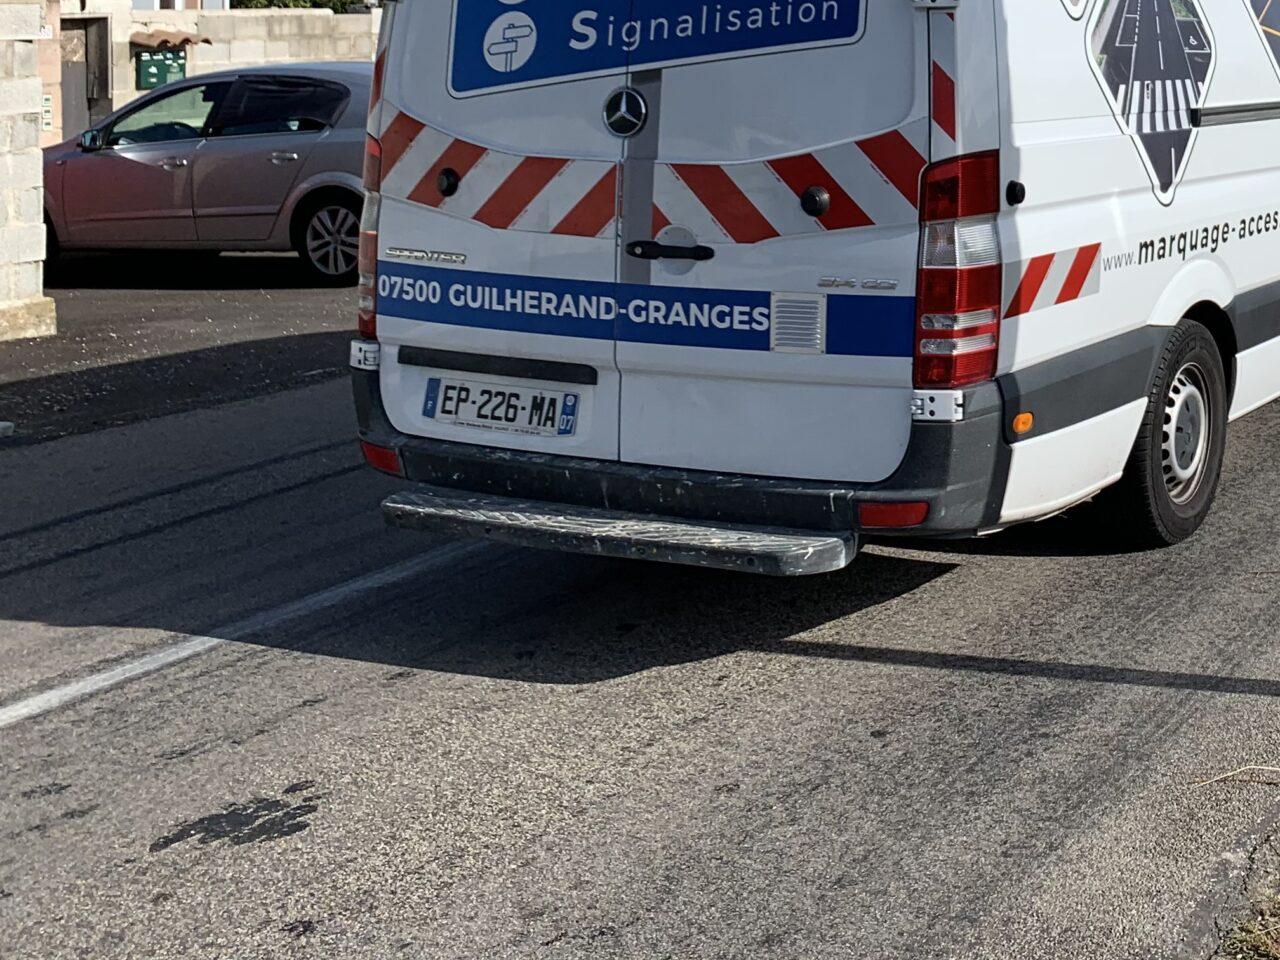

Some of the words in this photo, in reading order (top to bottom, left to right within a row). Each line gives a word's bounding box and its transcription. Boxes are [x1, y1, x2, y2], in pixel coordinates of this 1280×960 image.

[378, 274, 442, 304] 07500
[449, 283, 770, 332] GUILHERAND-GRANGES
[559, 414, 575, 430] 07
